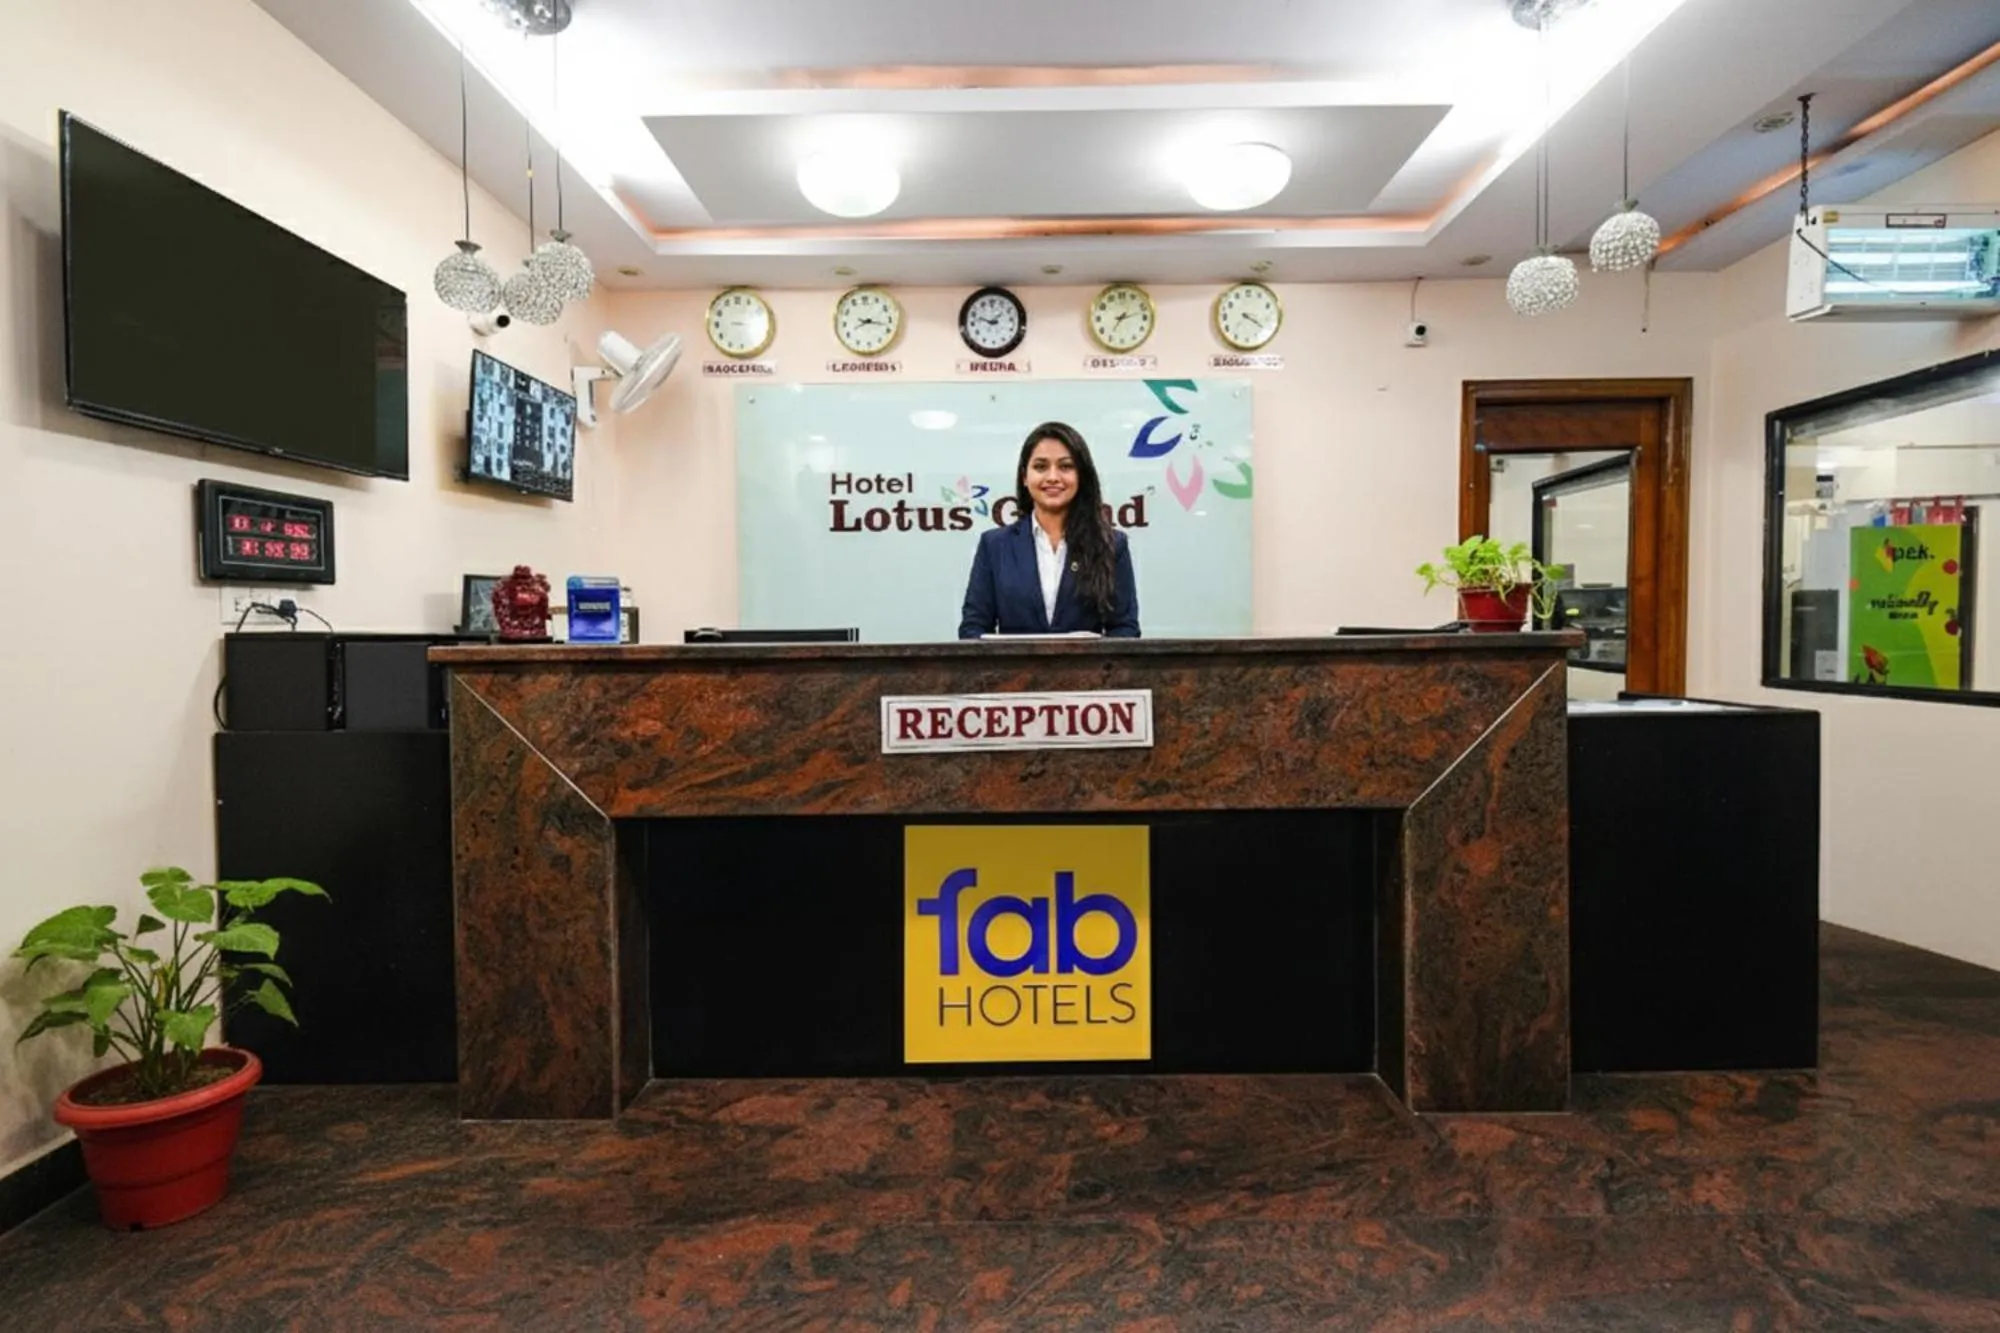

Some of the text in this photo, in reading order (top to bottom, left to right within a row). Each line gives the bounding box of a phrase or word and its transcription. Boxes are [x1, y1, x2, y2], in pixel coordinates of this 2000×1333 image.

[830, 472, 914, 495] Hotel
[829, 499, 974, 532] Lotus
[896, 702, 1136, 740] RECEPTION
[917, 867, 1138, 977] fab
[938, 982, 1136, 1027] HOTELS
